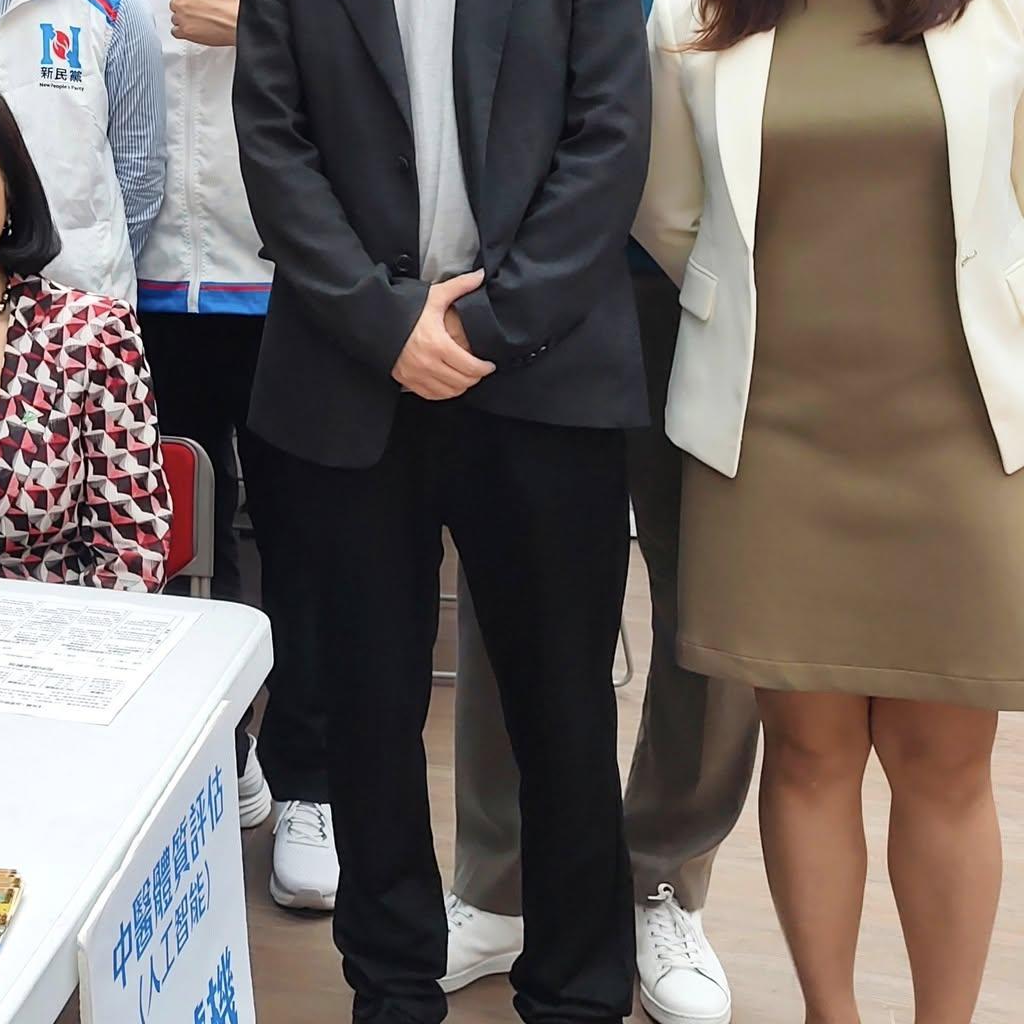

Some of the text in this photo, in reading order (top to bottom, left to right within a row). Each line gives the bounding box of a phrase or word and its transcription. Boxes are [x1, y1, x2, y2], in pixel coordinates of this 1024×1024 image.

[40, 66, 83, 83] 新民黨
[112, 765, 224, 989] 中醫體質評估
